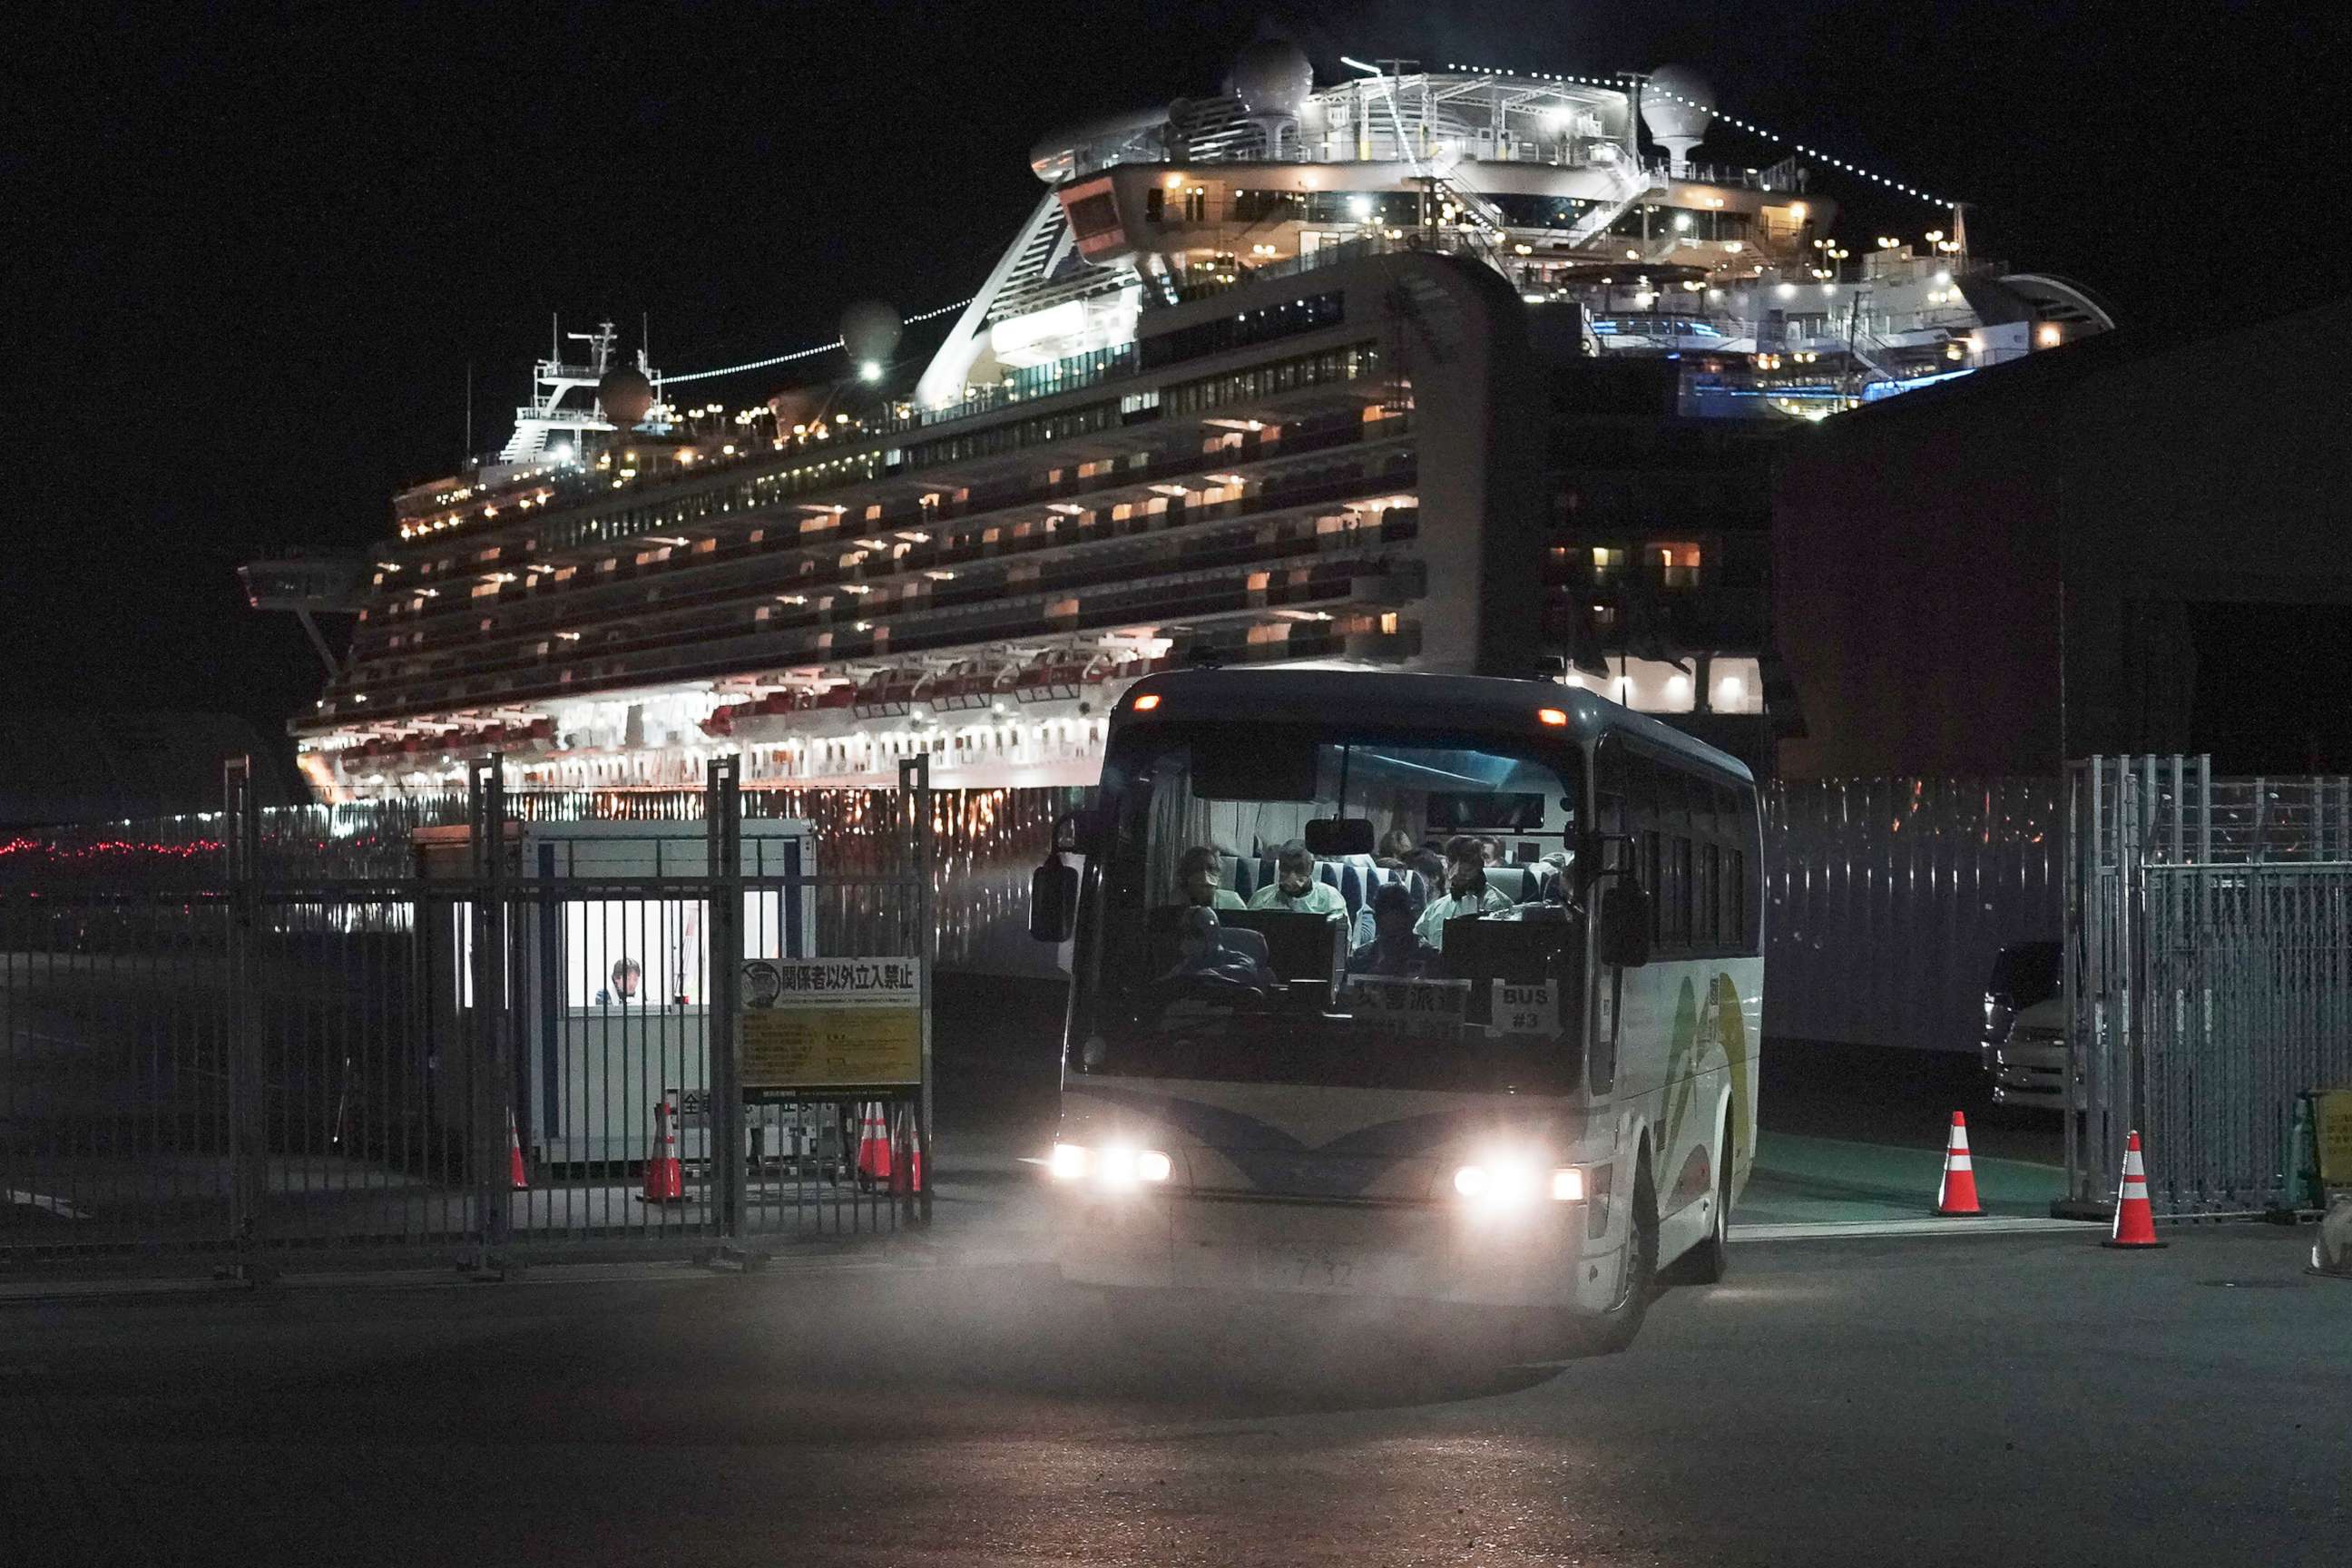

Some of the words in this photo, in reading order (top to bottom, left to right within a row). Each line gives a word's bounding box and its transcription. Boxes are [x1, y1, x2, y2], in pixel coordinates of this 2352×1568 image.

[781, 964, 914, 991] 関係者以外立入禁止
[1504, 989, 1548, 1004] BUS
[1513, 1014, 1539, 1028] #3
